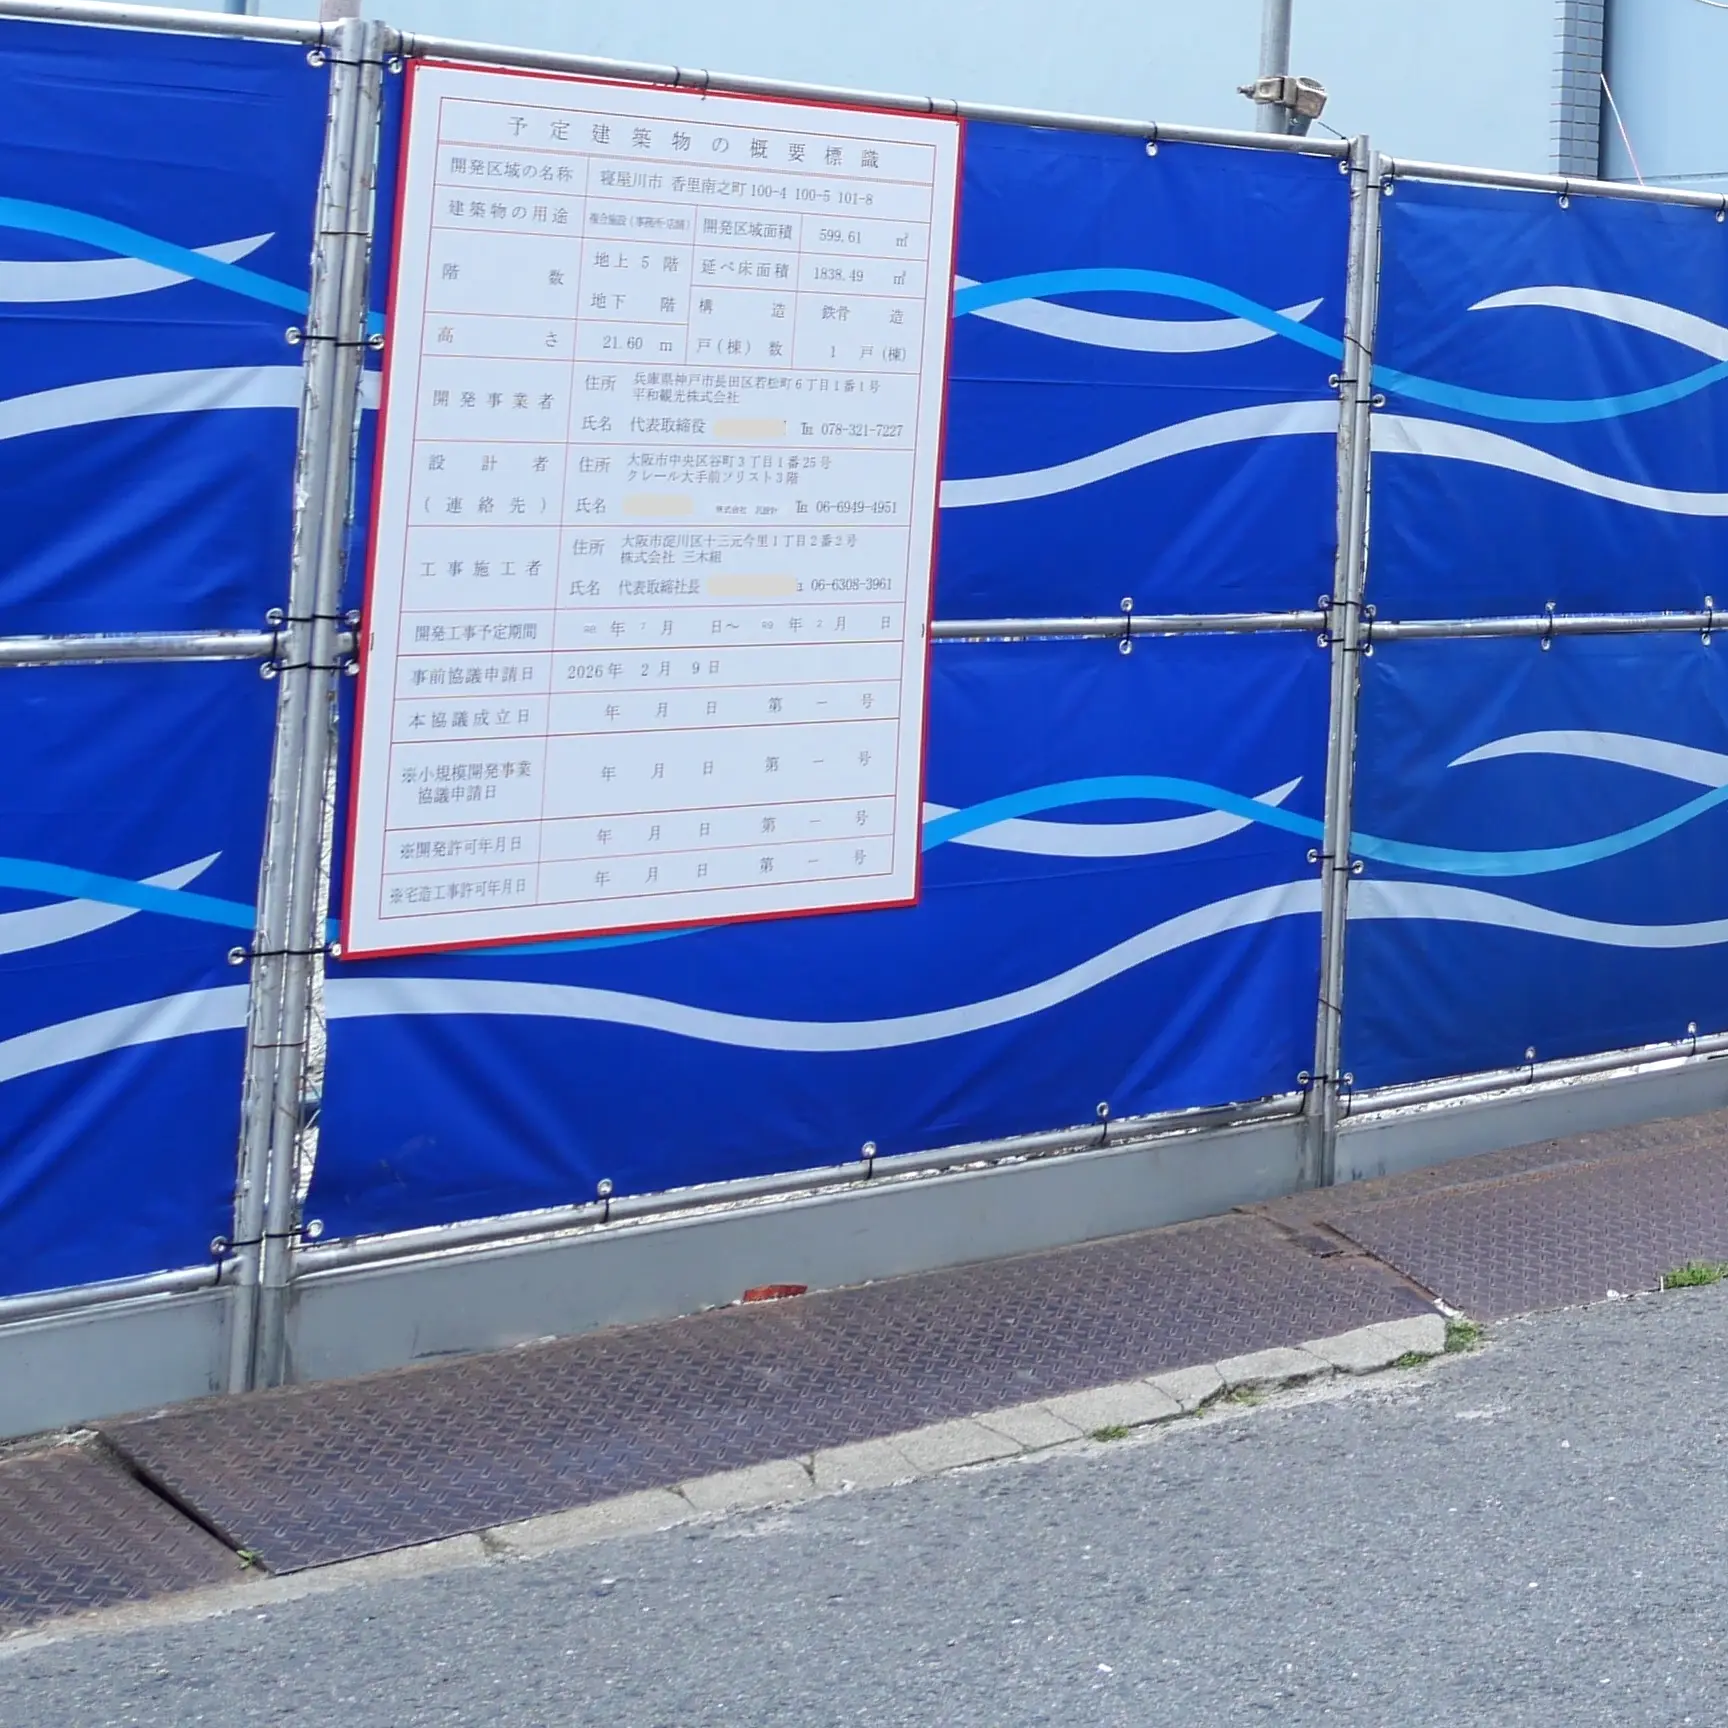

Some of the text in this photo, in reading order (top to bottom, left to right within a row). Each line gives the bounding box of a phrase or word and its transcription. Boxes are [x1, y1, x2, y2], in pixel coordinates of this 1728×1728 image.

[507, 115, 880, 170] 予定建築物の概要標識
[450, 157, 574, 183] 開発区域の名称
[600, 169, 663, 191] 寝屋川市
[795, 188, 831, 203] 100-5
[838, 191, 874, 206] 101-8
[449, 199, 862, 245] 建築物の用途 開発区域面積 599.61
[701, 257, 864, 283] 延べ床面積 1838.49
[602, 335, 643, 350] 21.60
[432, 389, 555, 411] 開発事業者
[584, 374, 618, 393] 住所
[581, 415, 904, 438] 氏名 代表取締役 078-321-7227
[578, 455, 612, 474] 住所
[575, 497, 607, 514] 氏名
[420, 559, 543, 578] 工事施工者
[572, 538, 605, 556] 住所
[568, 579, 601, 597] 氏名
[414, 622, 538, 643] 開発工事予定期間
[411, 665, 534, 687] 事前協議申請日
[408, 708, 530, 729] 本協議成立日
[417, 784, 497, 805] 協議申請日
